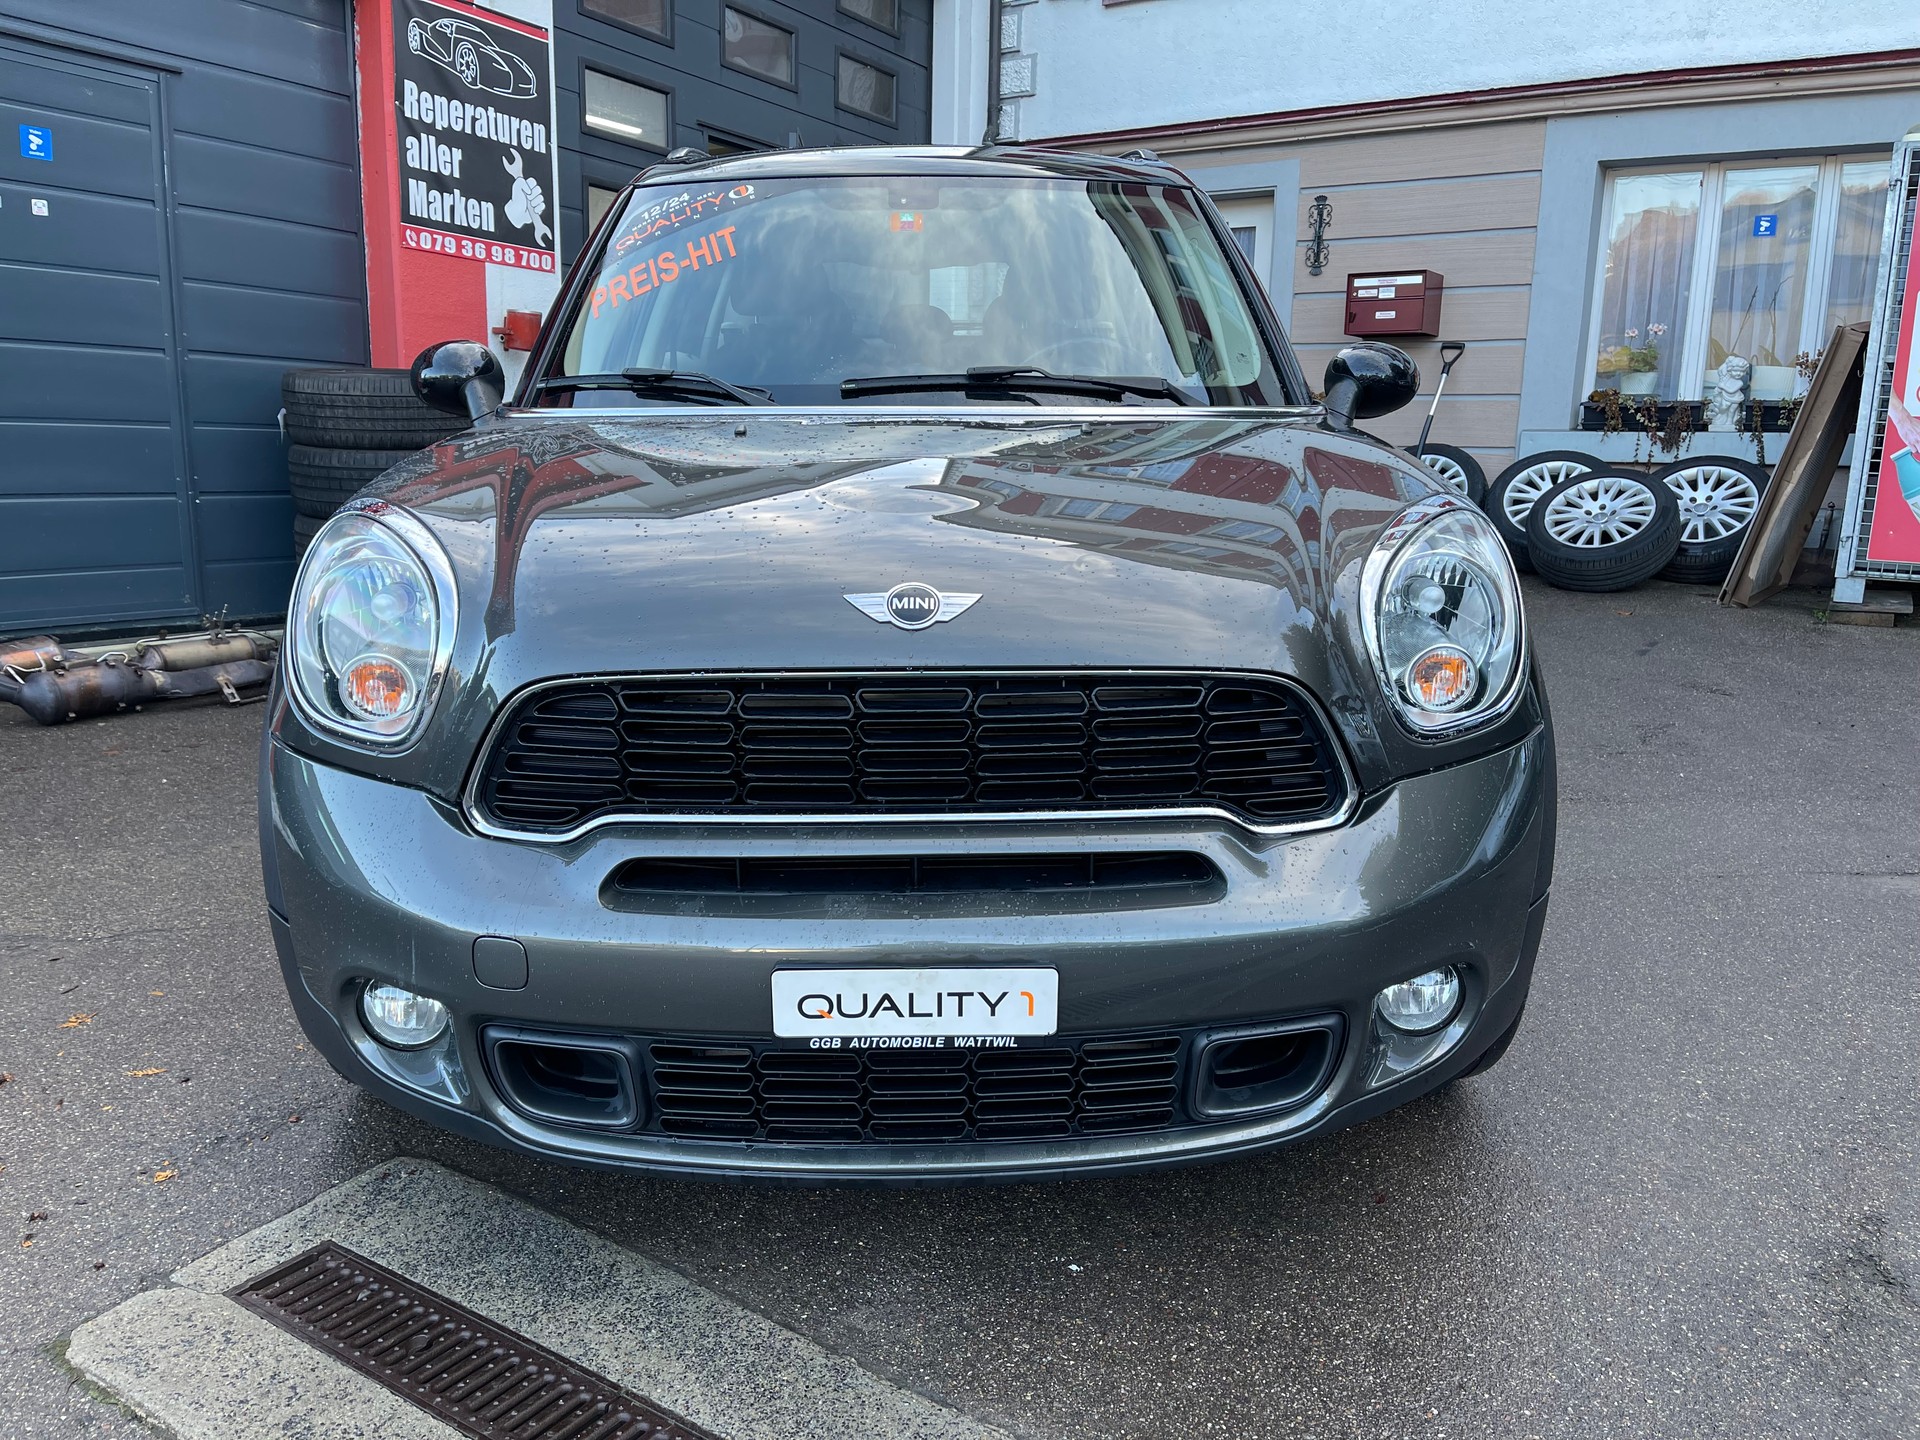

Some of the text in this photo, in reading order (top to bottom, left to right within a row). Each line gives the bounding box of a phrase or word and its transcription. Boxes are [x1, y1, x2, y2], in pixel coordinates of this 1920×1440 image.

[403, 79, 547, 154] Reperaturen
[405, 132, 463, 179] aller
[408, 178, 495, 232] Marken
[615, 192, 725, 250] QUALITY
[641, 192, 691, 220] 12/24
[419, 231, 552, 270] 079 36 98 700
[589, 225, 737, 320] PREIS-HIT
[892, 597, 935, 610] MINI
[797, 991, 1035, 1020] QUALITY 1
[809, 1036, 1018, 1049] GGB AUTOMOBILE WATTWIL
